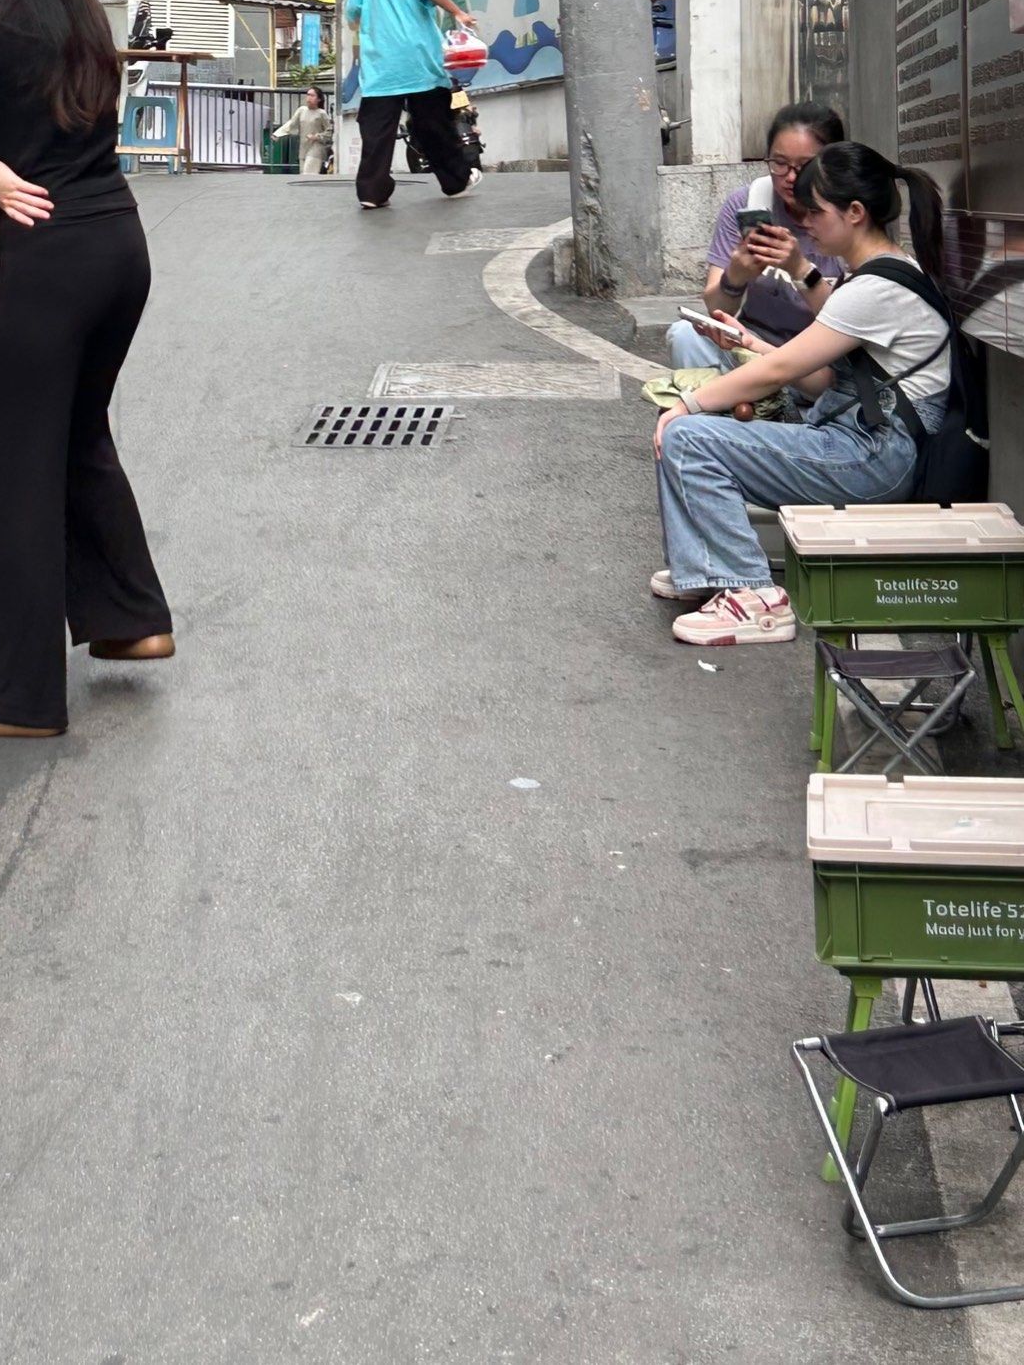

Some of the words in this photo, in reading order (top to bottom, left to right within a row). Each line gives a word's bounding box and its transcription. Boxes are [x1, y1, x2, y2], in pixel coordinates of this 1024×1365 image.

[876, 595, 904, 605] Made
[939, 597, 958, 605] you
[925, 922, 965, 936] Made
[995, 924, 1016, 937] for
